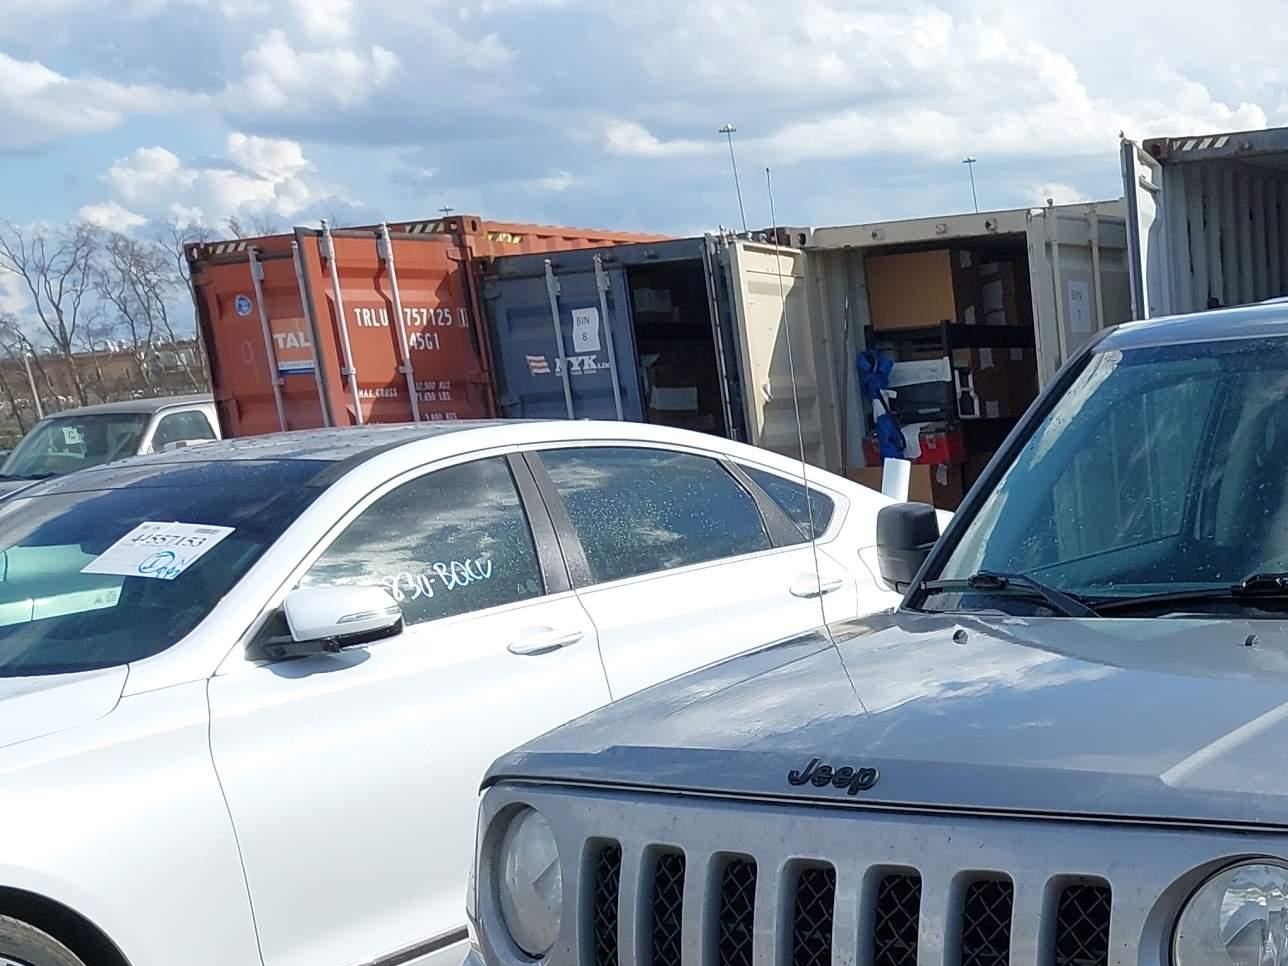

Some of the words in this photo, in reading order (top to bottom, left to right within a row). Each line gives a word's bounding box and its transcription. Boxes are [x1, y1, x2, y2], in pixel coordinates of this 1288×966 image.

[354, 308, 389, 327] TRLU
[403, 307, 452, 327] 757125
[576, 316, 590, 326] BIN
[408, 332, 440, 351] 45G1
[787, 758, 879, 796] Jeep
